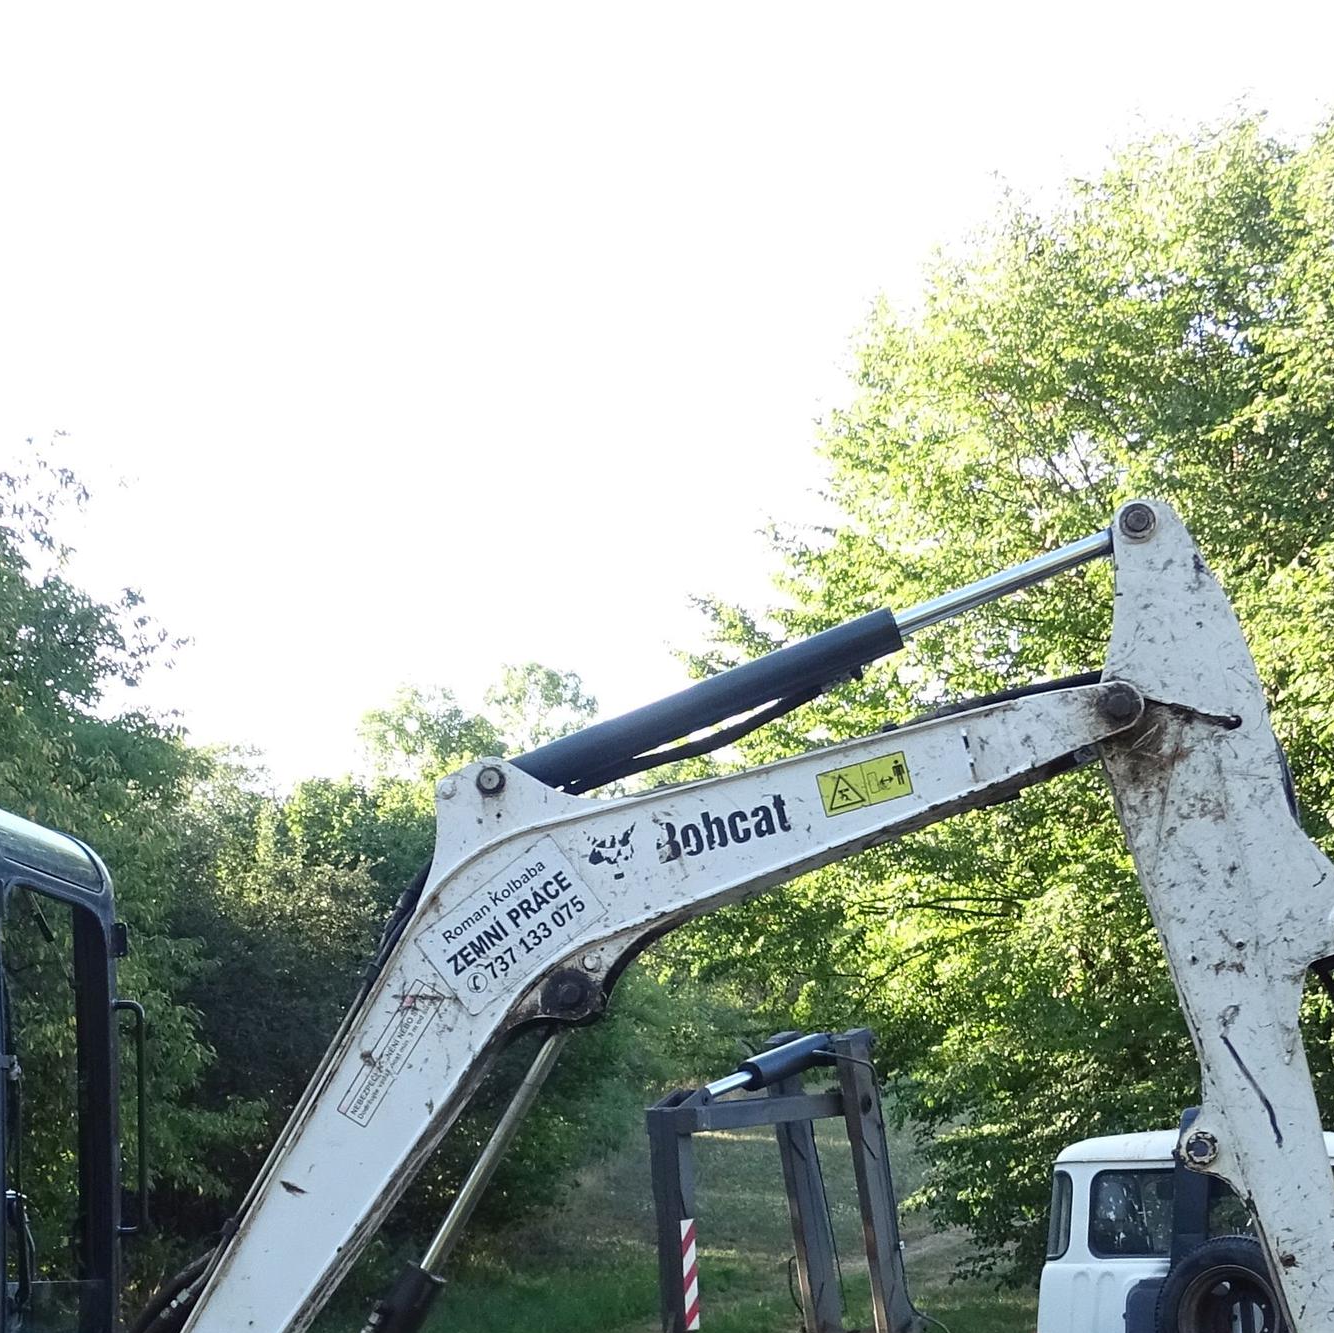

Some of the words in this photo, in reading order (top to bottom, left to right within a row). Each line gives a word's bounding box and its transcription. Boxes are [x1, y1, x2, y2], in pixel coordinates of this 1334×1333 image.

[442, 905, 491, 944] Roman
[489, 861, 546, 907] Kolbaba
[447, 915, 510, 976] ZEMNÍ
[506, 871, 572, 928] PRÁCE
[485, 947, 518, 979] 737
[519, 922, 552, 954] 133
[551, 895, 585, 928] 075
